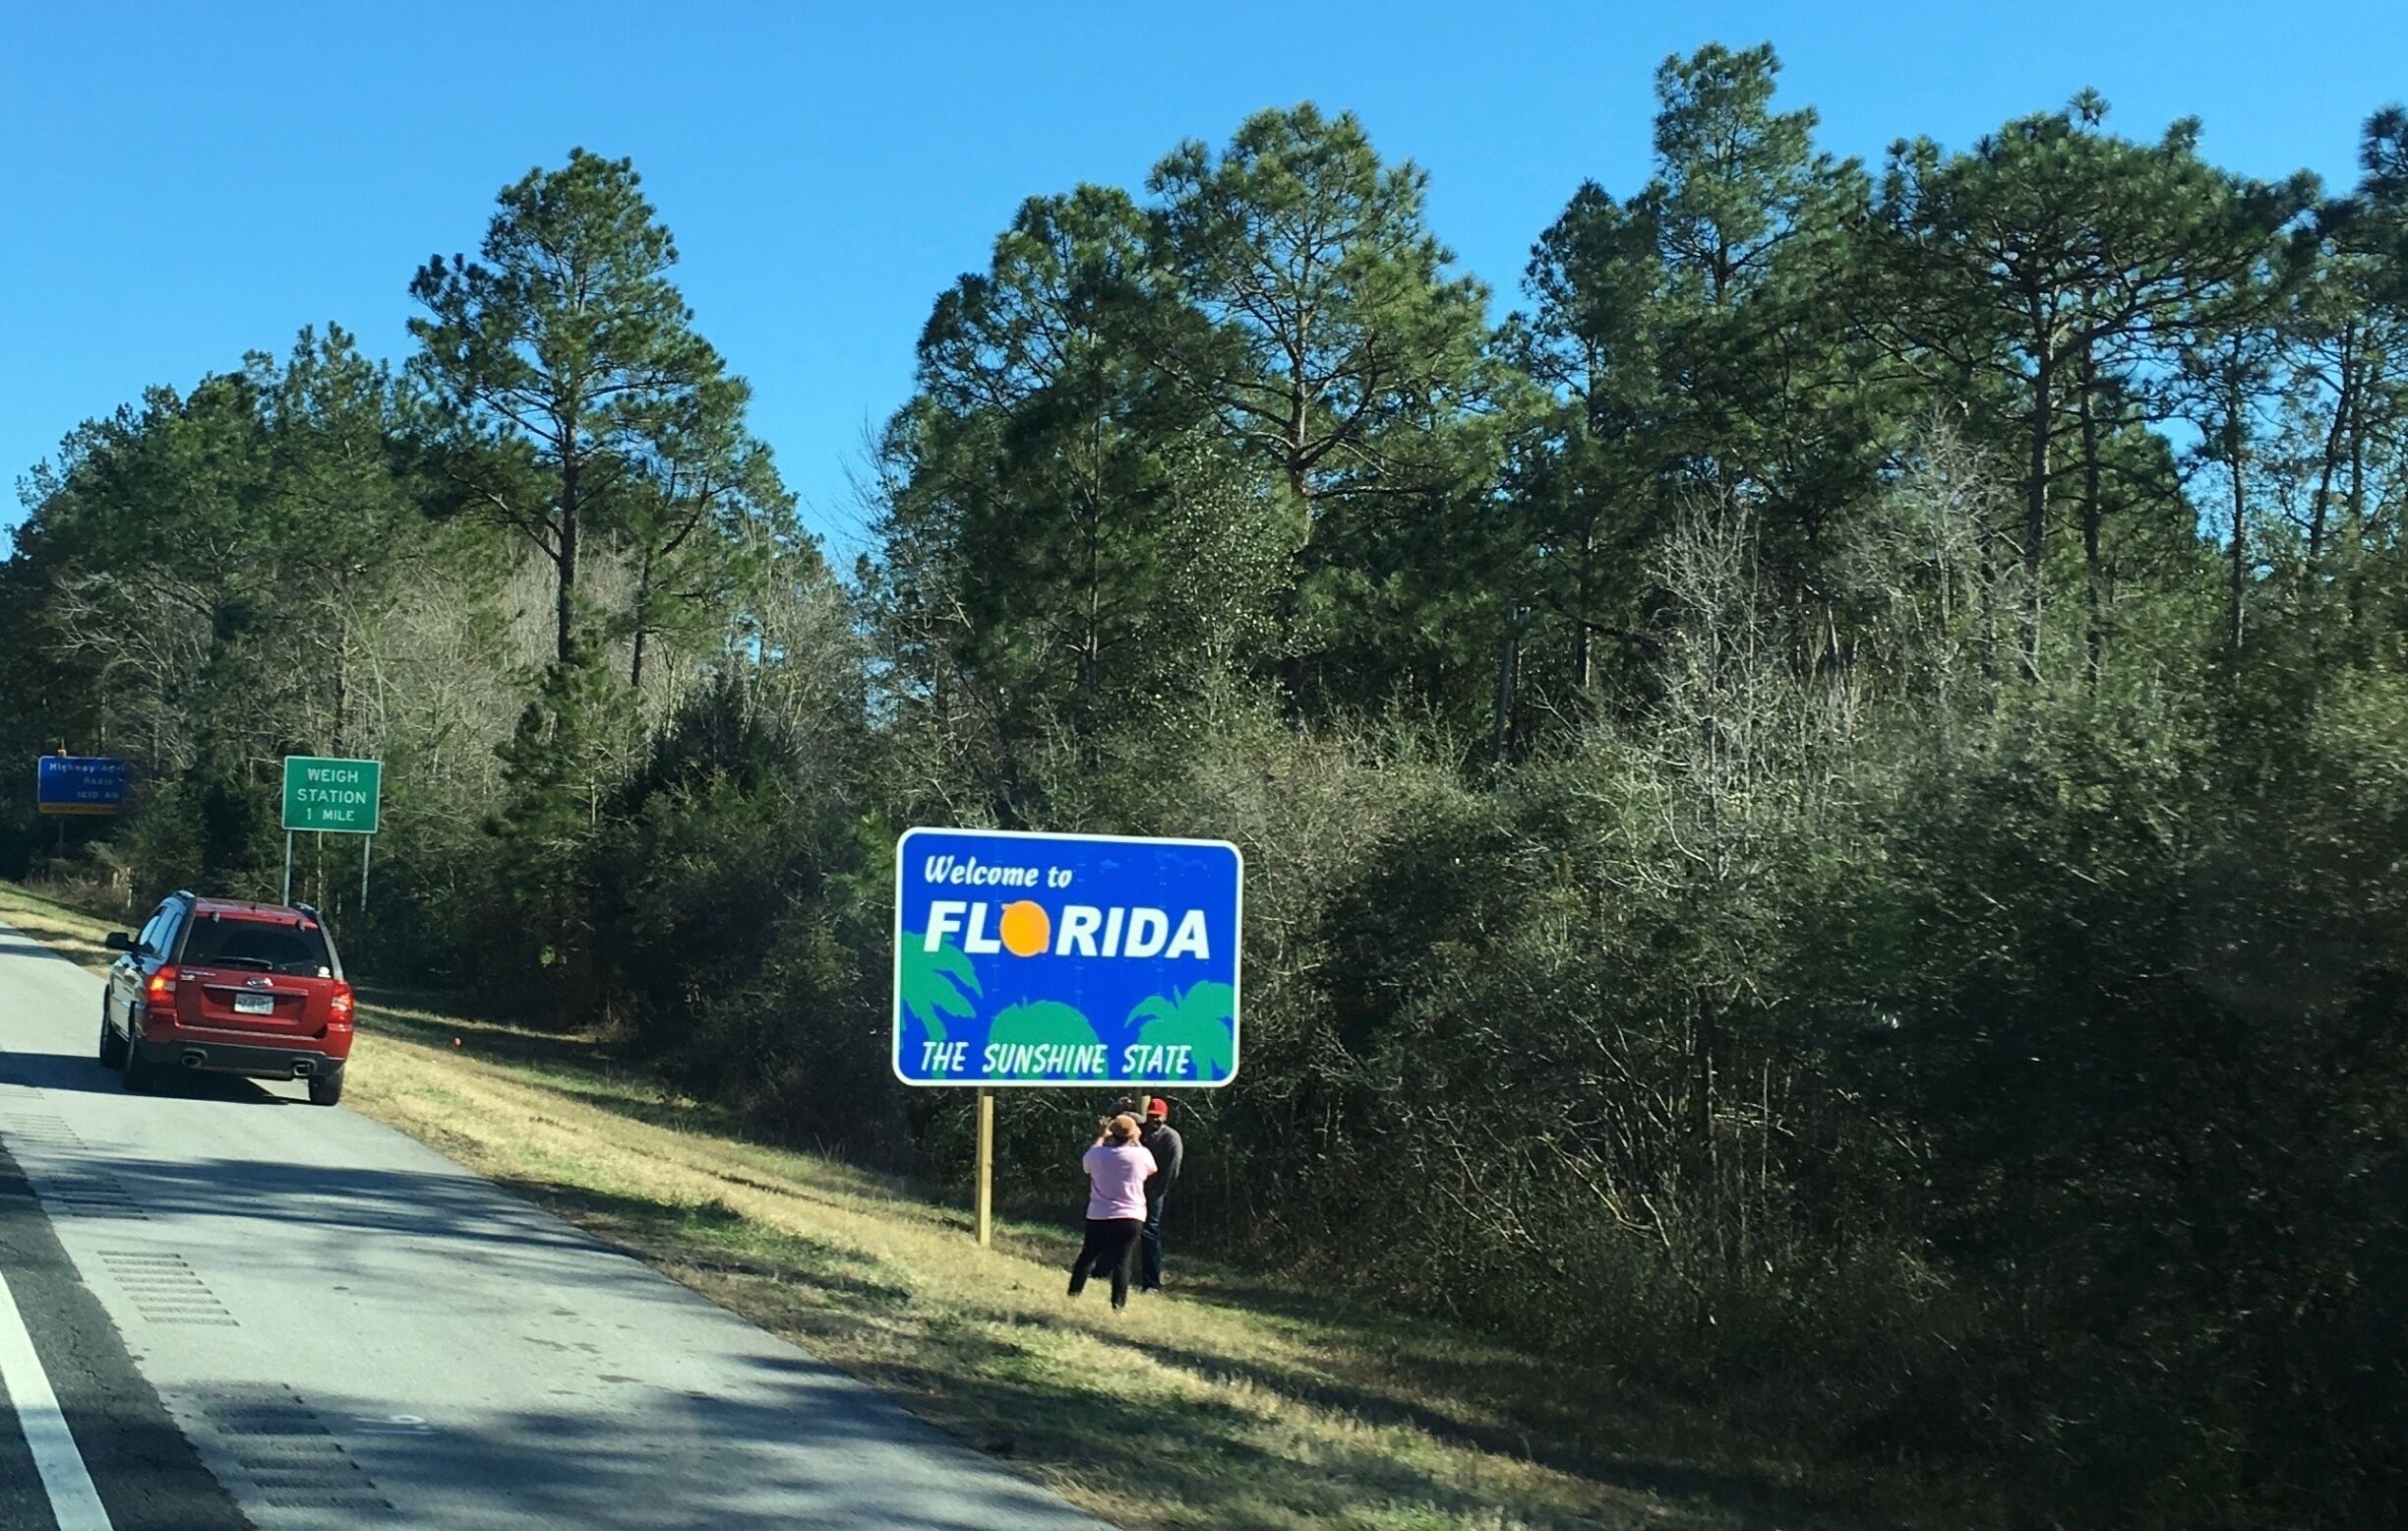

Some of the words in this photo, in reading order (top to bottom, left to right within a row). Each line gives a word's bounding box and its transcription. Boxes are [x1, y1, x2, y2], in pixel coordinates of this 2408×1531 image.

[49, 763, 95, 773] Highway
[307, 767, 359, 783] WEIGH
[297, 788, 367, 804] STATION
[306, 807, 312, 821] 1
[322, 809, 355, 822] MILE
[924, 854, 1040, 888] Welcome
[1047, 865, 1073, 888] to
[923, 899, 1211, 960] FLORIDA
[921, 1041, 970, 1072] THE
[982, 1043, 1109, 1074] SUNSHINE
[1121, 1044, 1193, 1074] STATE
